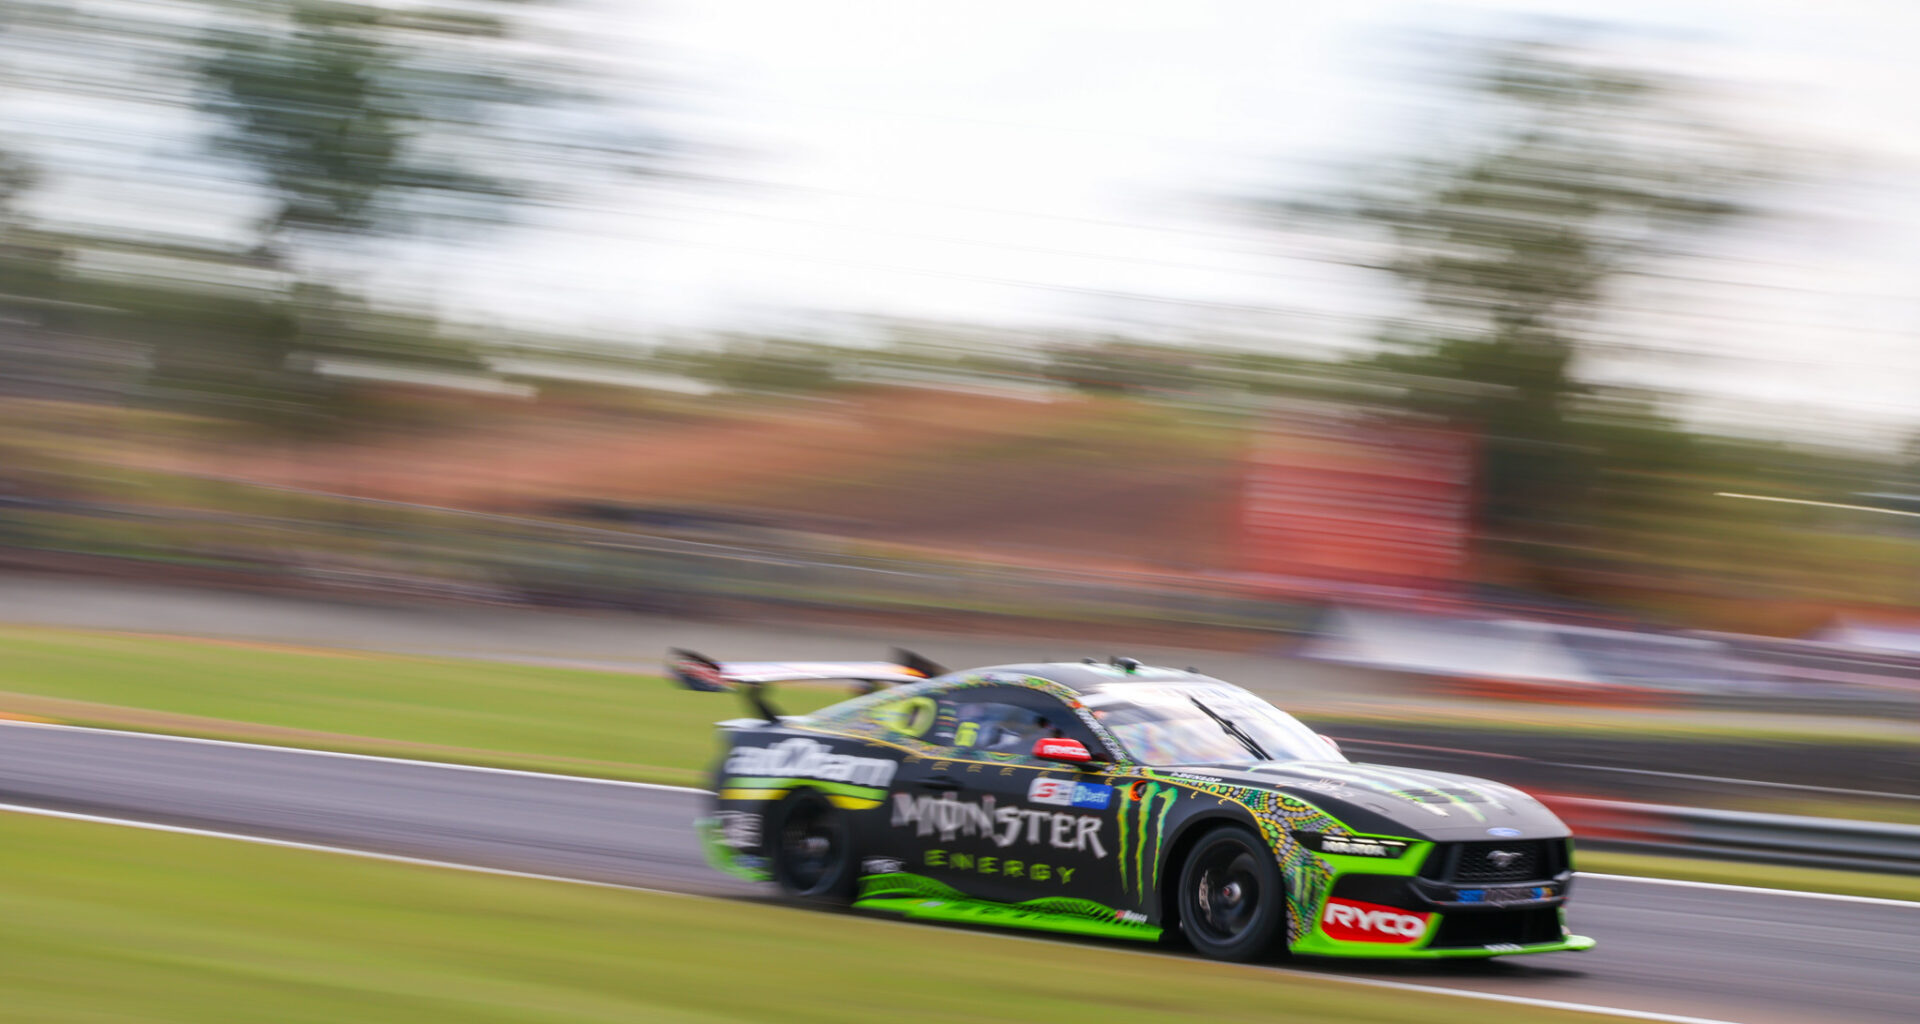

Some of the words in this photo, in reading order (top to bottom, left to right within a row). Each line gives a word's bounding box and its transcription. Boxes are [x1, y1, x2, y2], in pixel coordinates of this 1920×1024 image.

[891, 792, 1107, 858] MONSTER
[924, 850, 1075, 884] ENERGY
[1323, 902, 1427, 939] RYCO
